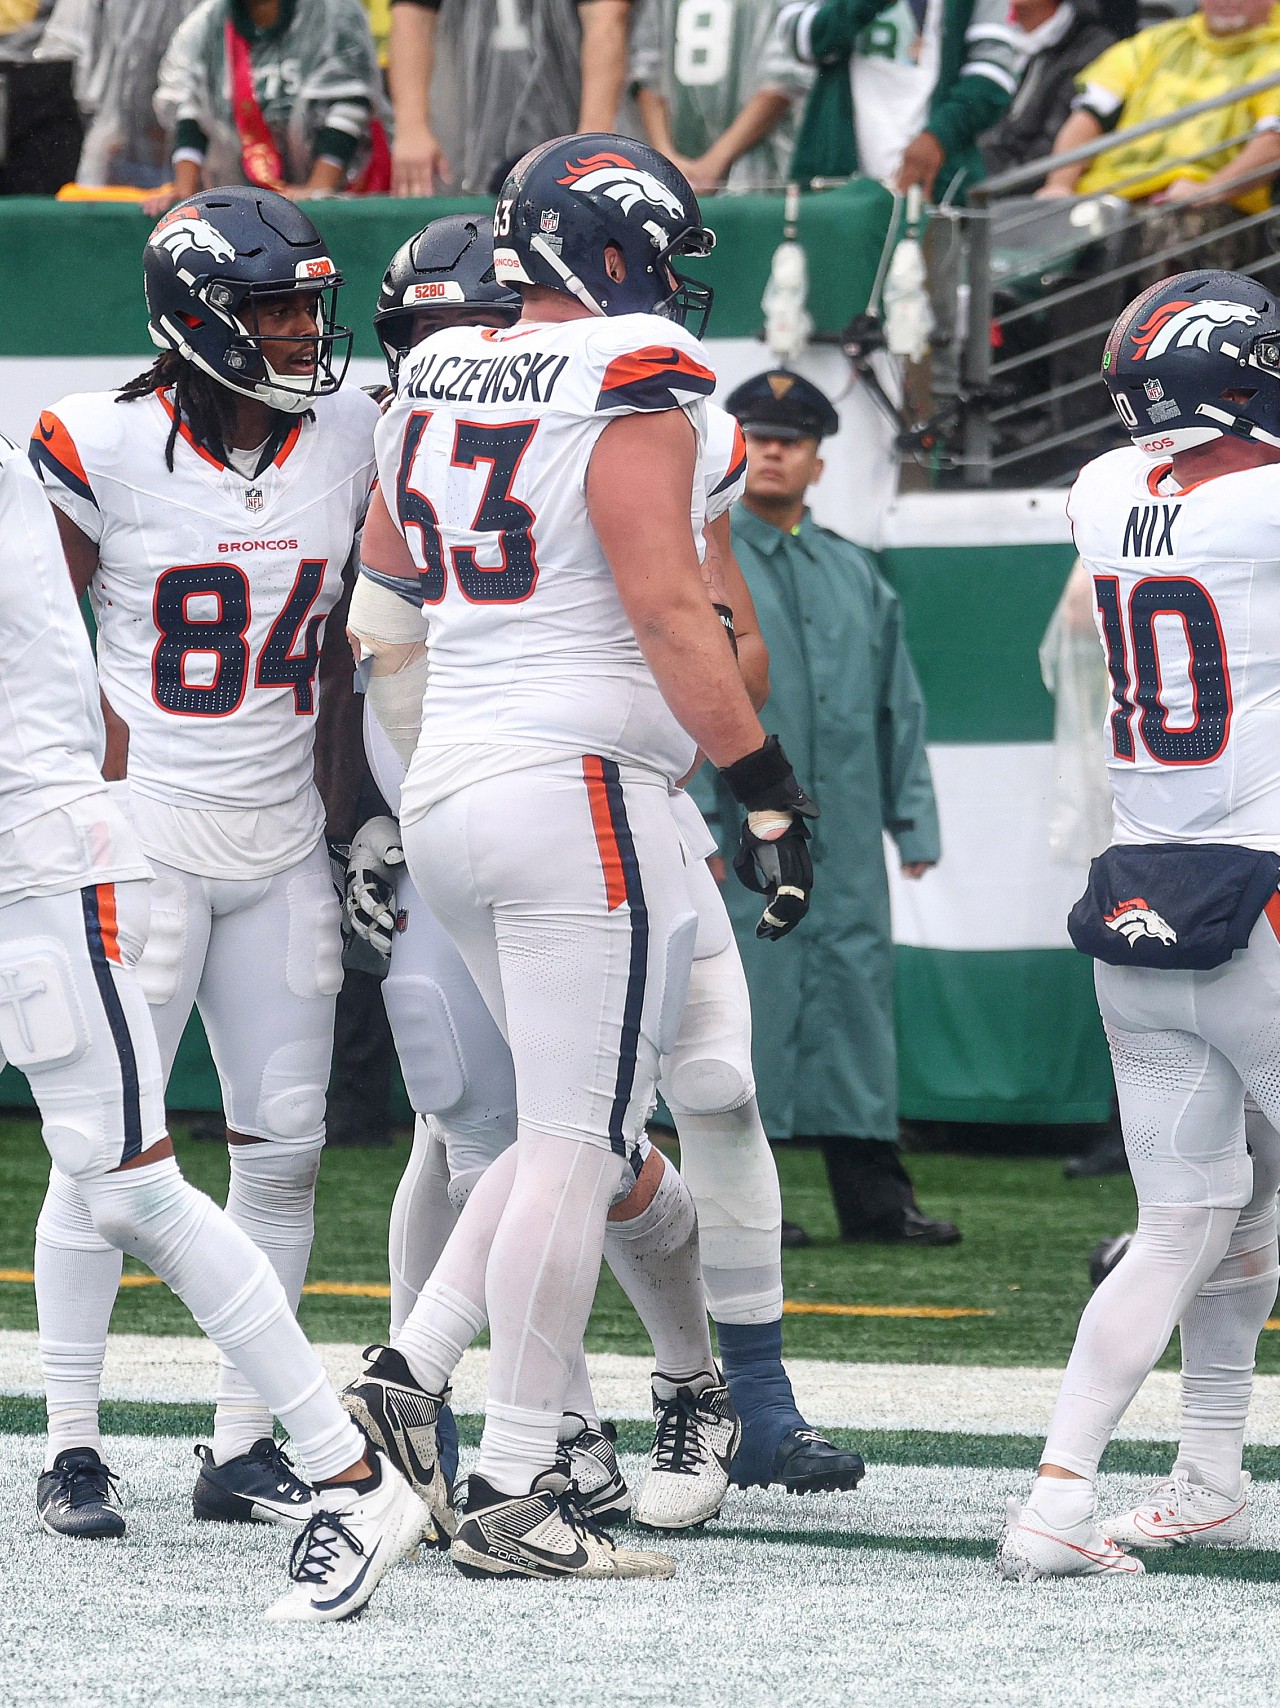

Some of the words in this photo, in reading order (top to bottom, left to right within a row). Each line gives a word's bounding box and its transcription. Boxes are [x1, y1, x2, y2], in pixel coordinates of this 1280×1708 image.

[674, 0, 732, 86] 8
[415, 283, 445, 299] 5280
[396, 410, 541, 606] 63
[1122, 504, 1182, 557] NIX
[217, 539, 298, 553] BRONCOS
[151, 558, 329, 718] 84
[1093, 574, 1233, 766] 10
[487, 1546, 539, 1569] FORCE
